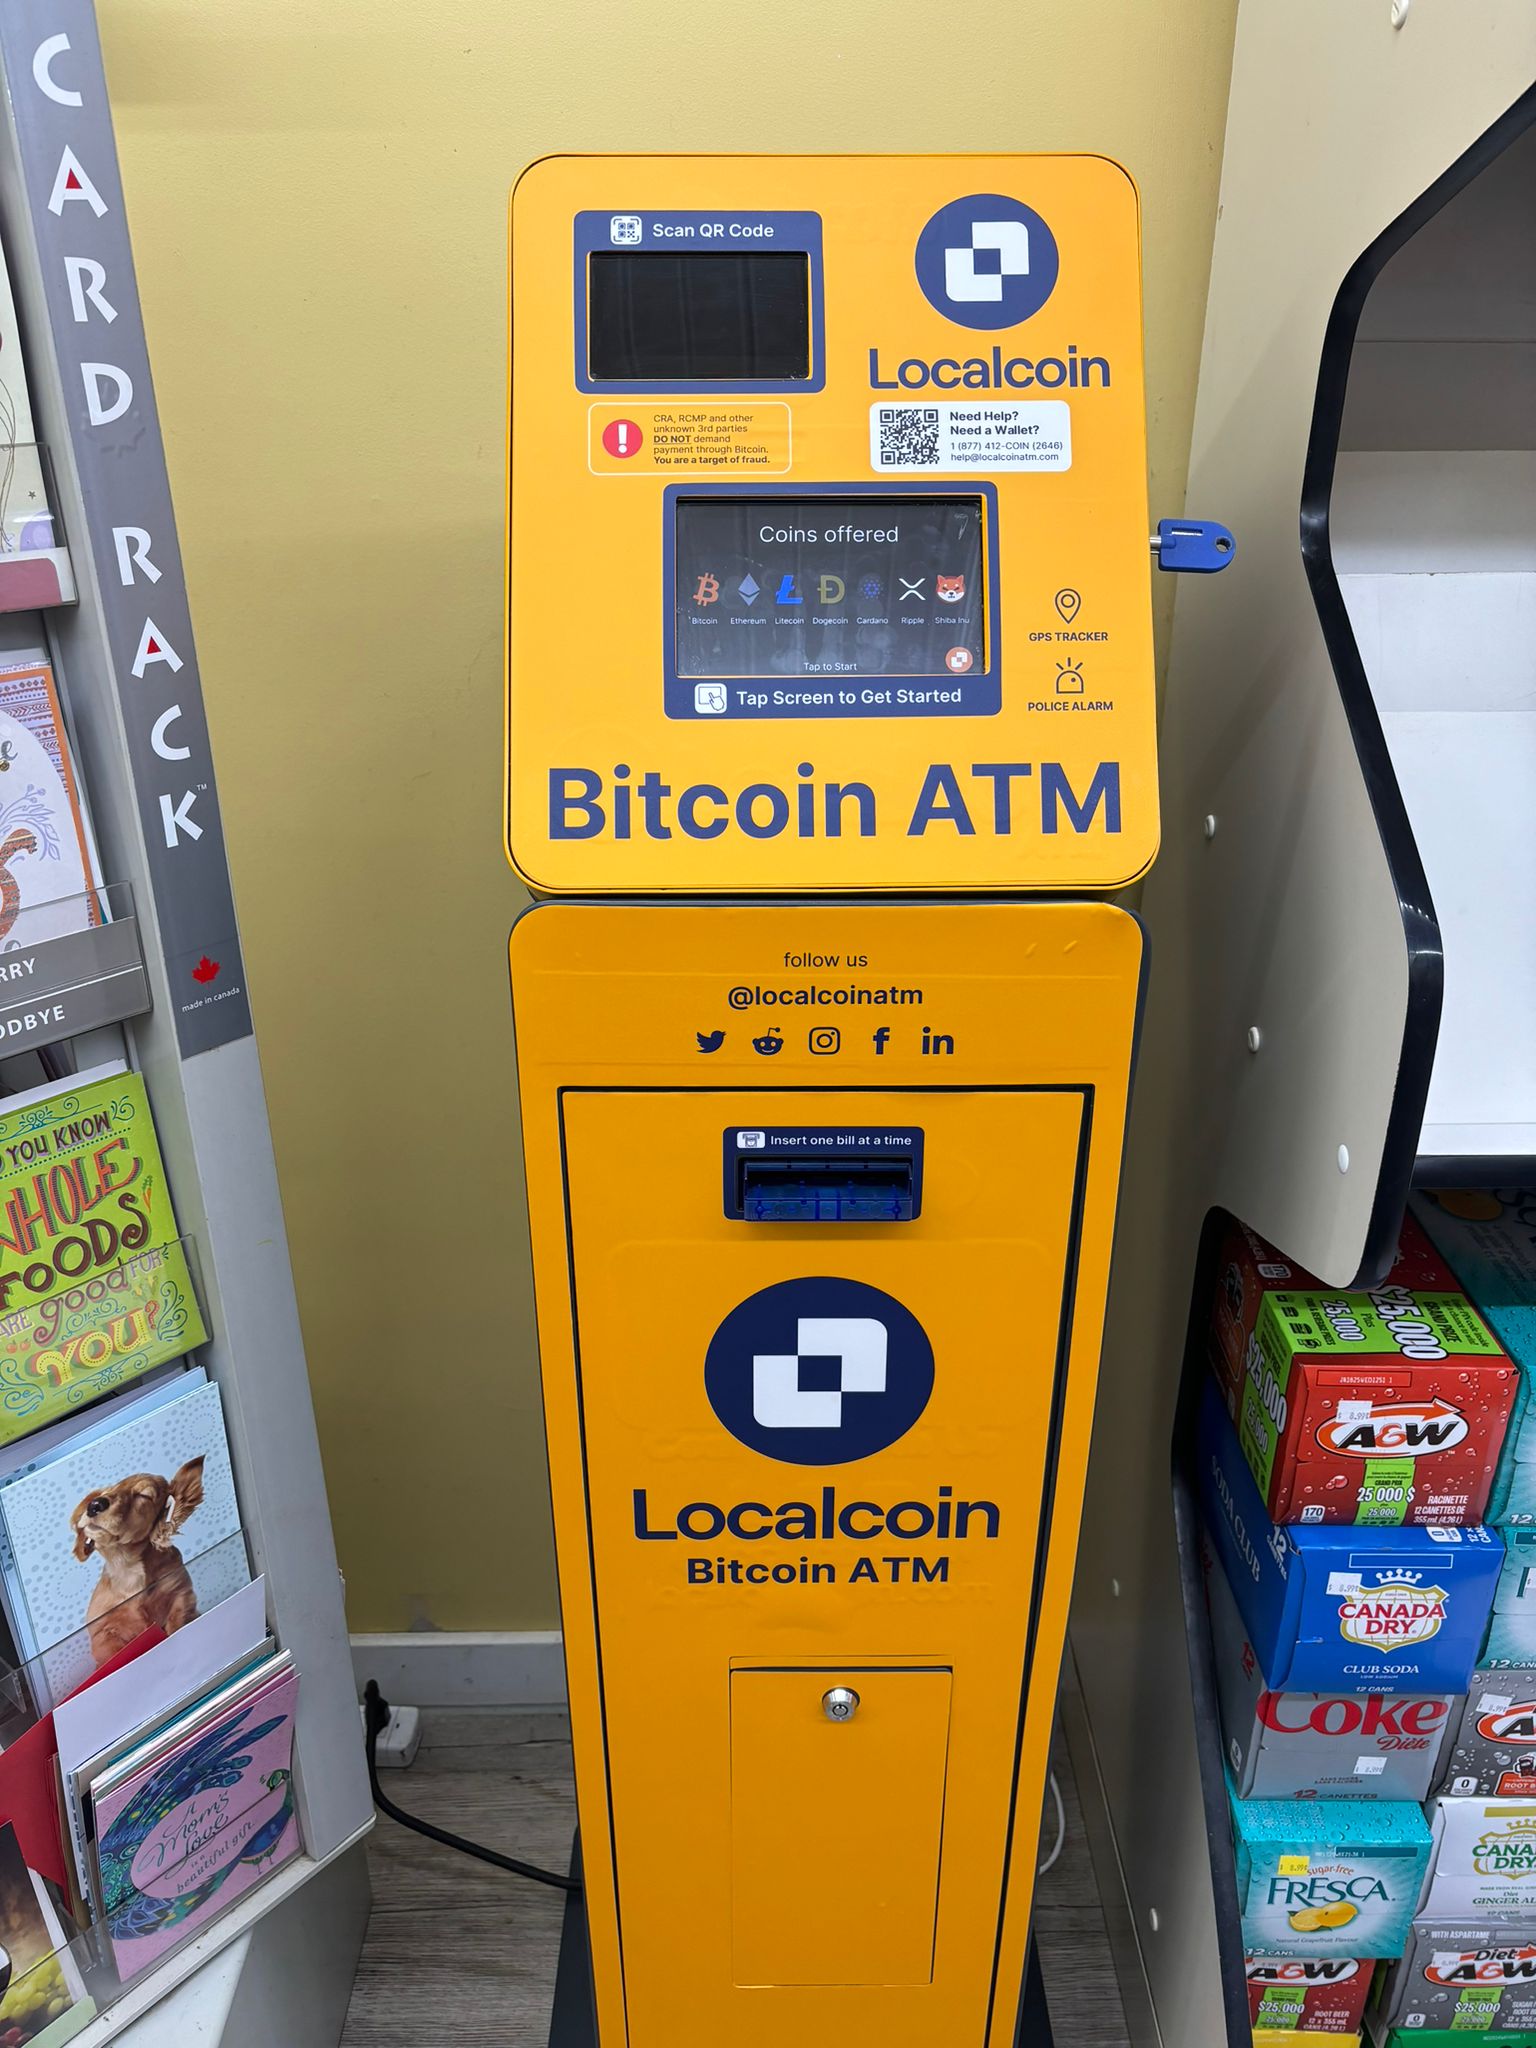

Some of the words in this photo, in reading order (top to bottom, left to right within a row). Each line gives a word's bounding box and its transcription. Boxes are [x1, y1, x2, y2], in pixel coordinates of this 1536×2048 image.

[653, 223, 695, 238] Scan
[700, 223, 725, 238] QR
[729, 223, 774, 238] Code
[869, 344, 1111, 390] Localcoin
[654, 414, 676, 425] CRA,
[679, 414, 707, 423] RCMP
[709, 414, 727, 423] and
[729, 414, 754, 423] other
[950, 411, 981, 421] Need
[984, 411, 1019, 422] Help?
[654, 425, 695, 433] unknown
[698, 425, 713, 433] 3rd
[715, 424, 748, 434] parties
[950, 426, 982, 435] Need
[995, 425, 1040, 435] Wallet?
[32, 32, 134, 427] CARD
[112, 526, 204, 849] RACK
[654, 435, 668, 444] DO
[670, 435, 691, 444] NOT
[693, 435, 731, 443] demand
[654, 446, 694, 455] payment
[696, 445, 732, 455] through
[734, 445, 769, 454] Bitcoin.
[951, 442, 956, 450] 1
[958, 441, 982, 451] (877)
[985, 441, 1030, 450] 412-COIN
[1032, 441, 1063, 451] (2646)
[699, 456, 728, 465] target
[730, 456, 740, 464] of
[742, 456, 770, 464] fraud.
[951, 453, 1059, 463] help@localcoinatm.com
[759, 526, 818, 543] Coins
[824, 525, 900, 543] offered
[692, 617, 718, 625] Bitcoin
[730, 617, 766, 625] Ethereum
[775, 617, 804, 625] Litecoin
[812, 617, 849, 626] Dogecoin
[857, 617, 888, 625] Cardano
[901, 617, 925, 626] Ripple
[935, 617, 956, 625] Shiba
[958, 617, 970, 625] Inu
[1029, 632, 1052, 642] GPS
[1055, 632, 1109, 641] TRACKER
[804, 662, 820, 673] Tap
[822, 663, 832, 672] to
[834, 662, 857, 672] Start
[736, 690, 768, 707] Tap
[773, 690, 835, 705] Screen
[839, 691, 856, 704] to
[861, 690, 895, 704] Get
[898, 688, 962, 703] Started
[1028, 702, 1069, 711] POLICE
[1072, 701, 1113, 711] ALARM
[548, 762, 876, 841] Bitcoin
[907, 761, 1122, 836] ATM
[784, 951, 840, 968] follow
[846, 955, 868, 968] us
[182, 1000, 203, 1013] made
[204, 996, 213, 1005] in
[213, 987, 241, 1003] canada
[727, 985, 924, 1010] @localcoinatm
[7, 1134, 50, 1169] YOU
[53, 1110, 114, 1150] KNOW
[771, 1135, 807, 1145] Insert
[810, 1137, 833, 1145] one
[837, 1135, 855, 1145] bill
[858, 1136, 870, 1145] at
[873, 1137, 881, 1145] a
[884, 1135, 912, 1145] time
[33, 1256, 131, 1347] good
[28, 1300, 162, 1386] YOU?
[1335, 1421, 1460, 1449] A&W
[1356, 1486, 1374, 1502] 25
[1376, 1486, 1404, 1501] 000
[1406, 1486, 1416, 1503] $
[1428, 1495, 1468, 1504] RACINETTE
[633, 1485, 1000, 1541] Localcoin
[1304, 1507, 1323, 1516] 170
[1456, 1505, 1466, 1514] DE
[1510, 1514, 1531, 1524] 12
[687, 1556, 835, 1585] Bitcoin
[848, 1556, 949, 1584] ATM
[1339, 1603, 1446, 1619] CANADA
[1364, 1620, 1418, 1635] DRY
[1343, 1665, 1380, 1674] CLUB
[1382, 1665, 1420, 1674] SODA
[1490, 1660, 1511, 1668] 12
[1255, 1690, 1449, 1736] Coke
[1376, 1735, 1431, 1751] Diète
[1292, 1789, 1318, 1799] 12
[177, 1842, 230, 1894] beautiful
[1494, 1857, 1536, 1869] DRY
[1306, 1863, 1355, 1877] sugar-free
[1267, 1876, 1391, 1908] FRESCA
[1472, 1897, 1520, 1905] GINGER
[1431, 1931, 1449, 1939] WITH
[1449, 1931, 1490, 1939] ASPARTAME
[1246, 1948, 1266, 1956] 12
[1474, 1948, 1518, 1961] Diet
[1247, 1960, 1352, 1979] A&W
[1314, 2010, 1332, 2018] ROOT
[1333, 2010, 1350, 2018] BEER
